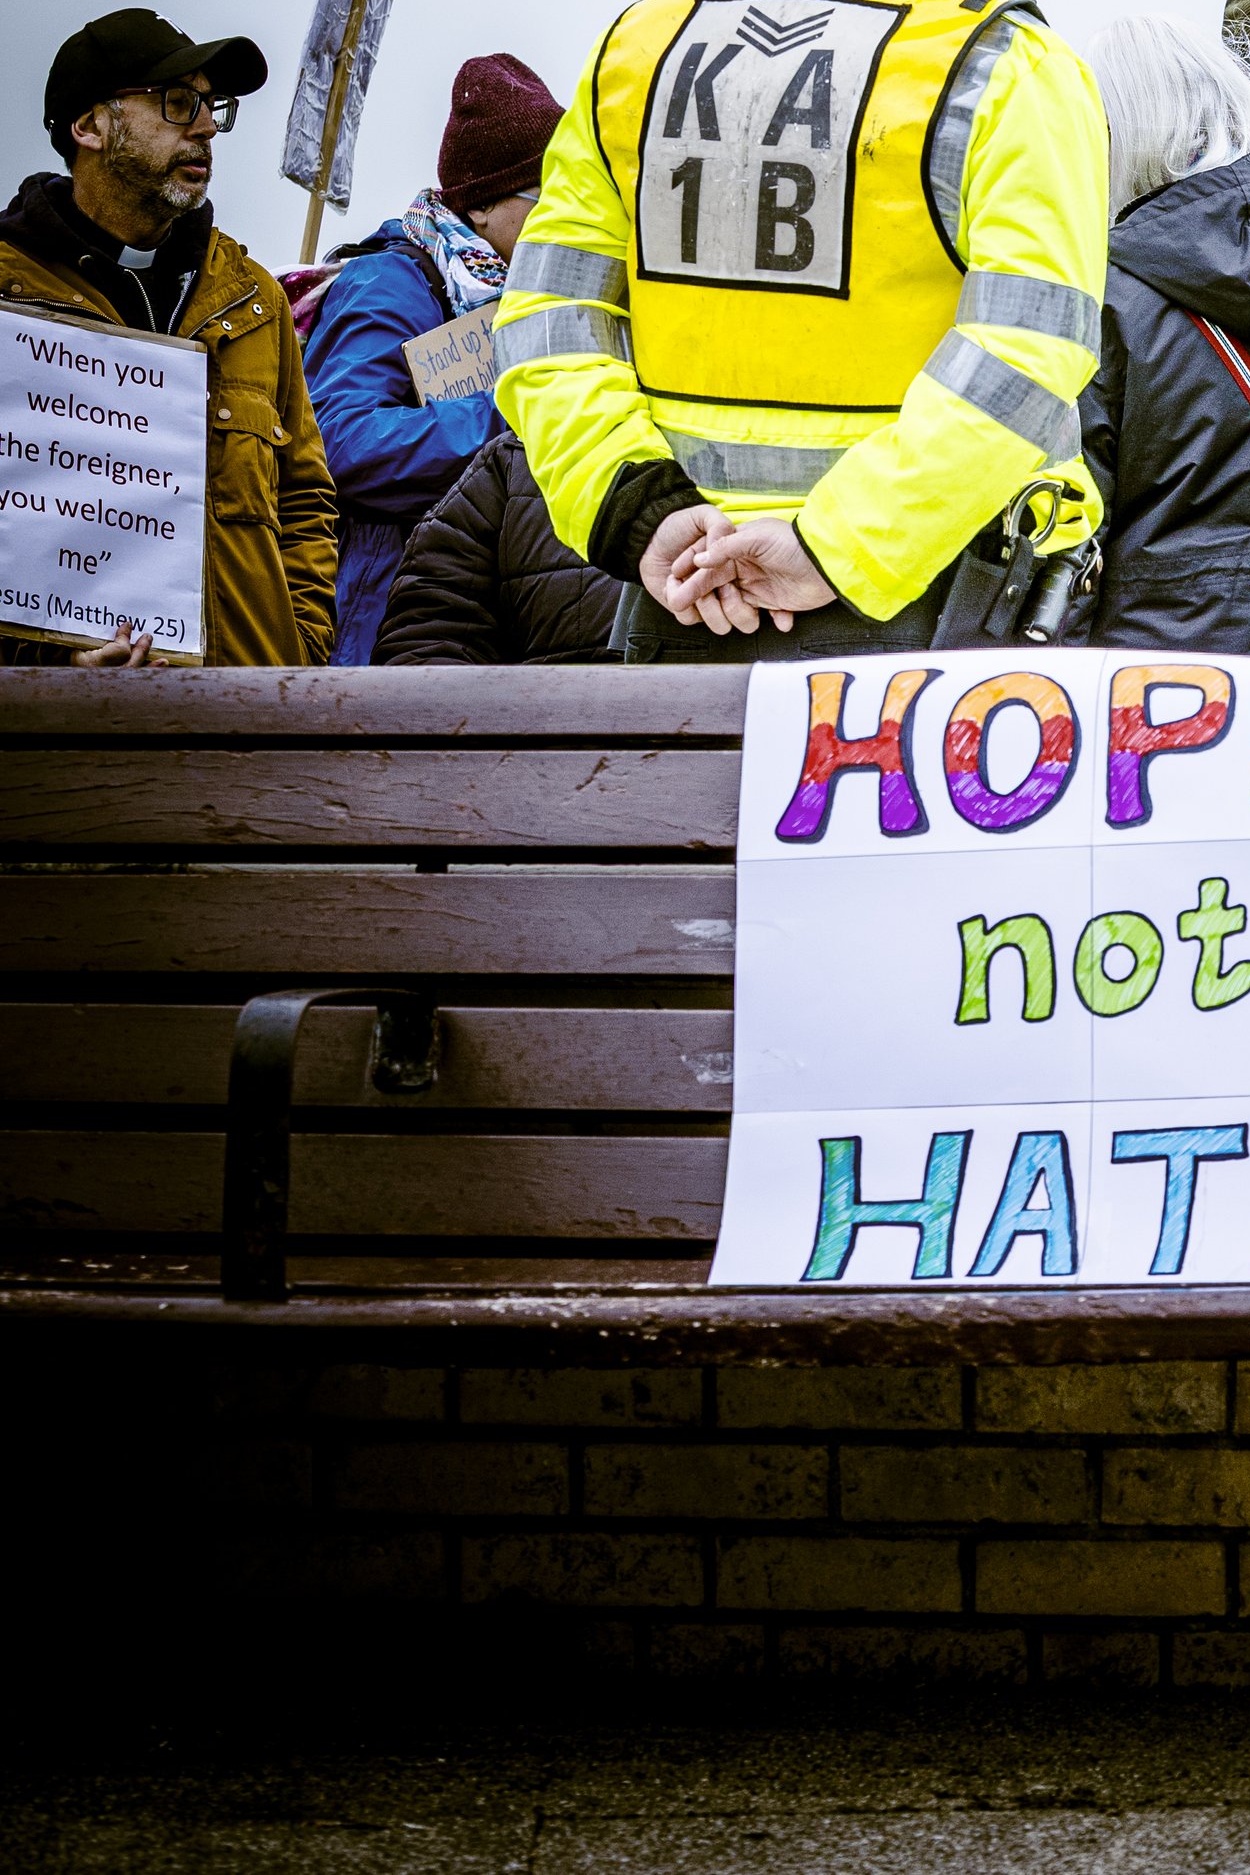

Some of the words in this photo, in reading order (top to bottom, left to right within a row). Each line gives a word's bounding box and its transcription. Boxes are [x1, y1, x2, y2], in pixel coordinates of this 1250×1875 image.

[15, 332, 105, 377] “When
[114, 361, 165, 388] you
[415, 332, 462, 384] Stand
[461, 331, 482, 363] up
[27, 391, 149, 433] welcome
[49, 440, 181, 495] foreigner,
[55, 498, 175, 540] welcome
[58, 547, 112, 575] me”
[47, 593, 147, 633] (Matthew
[153, 616, 186, 644] 25)
